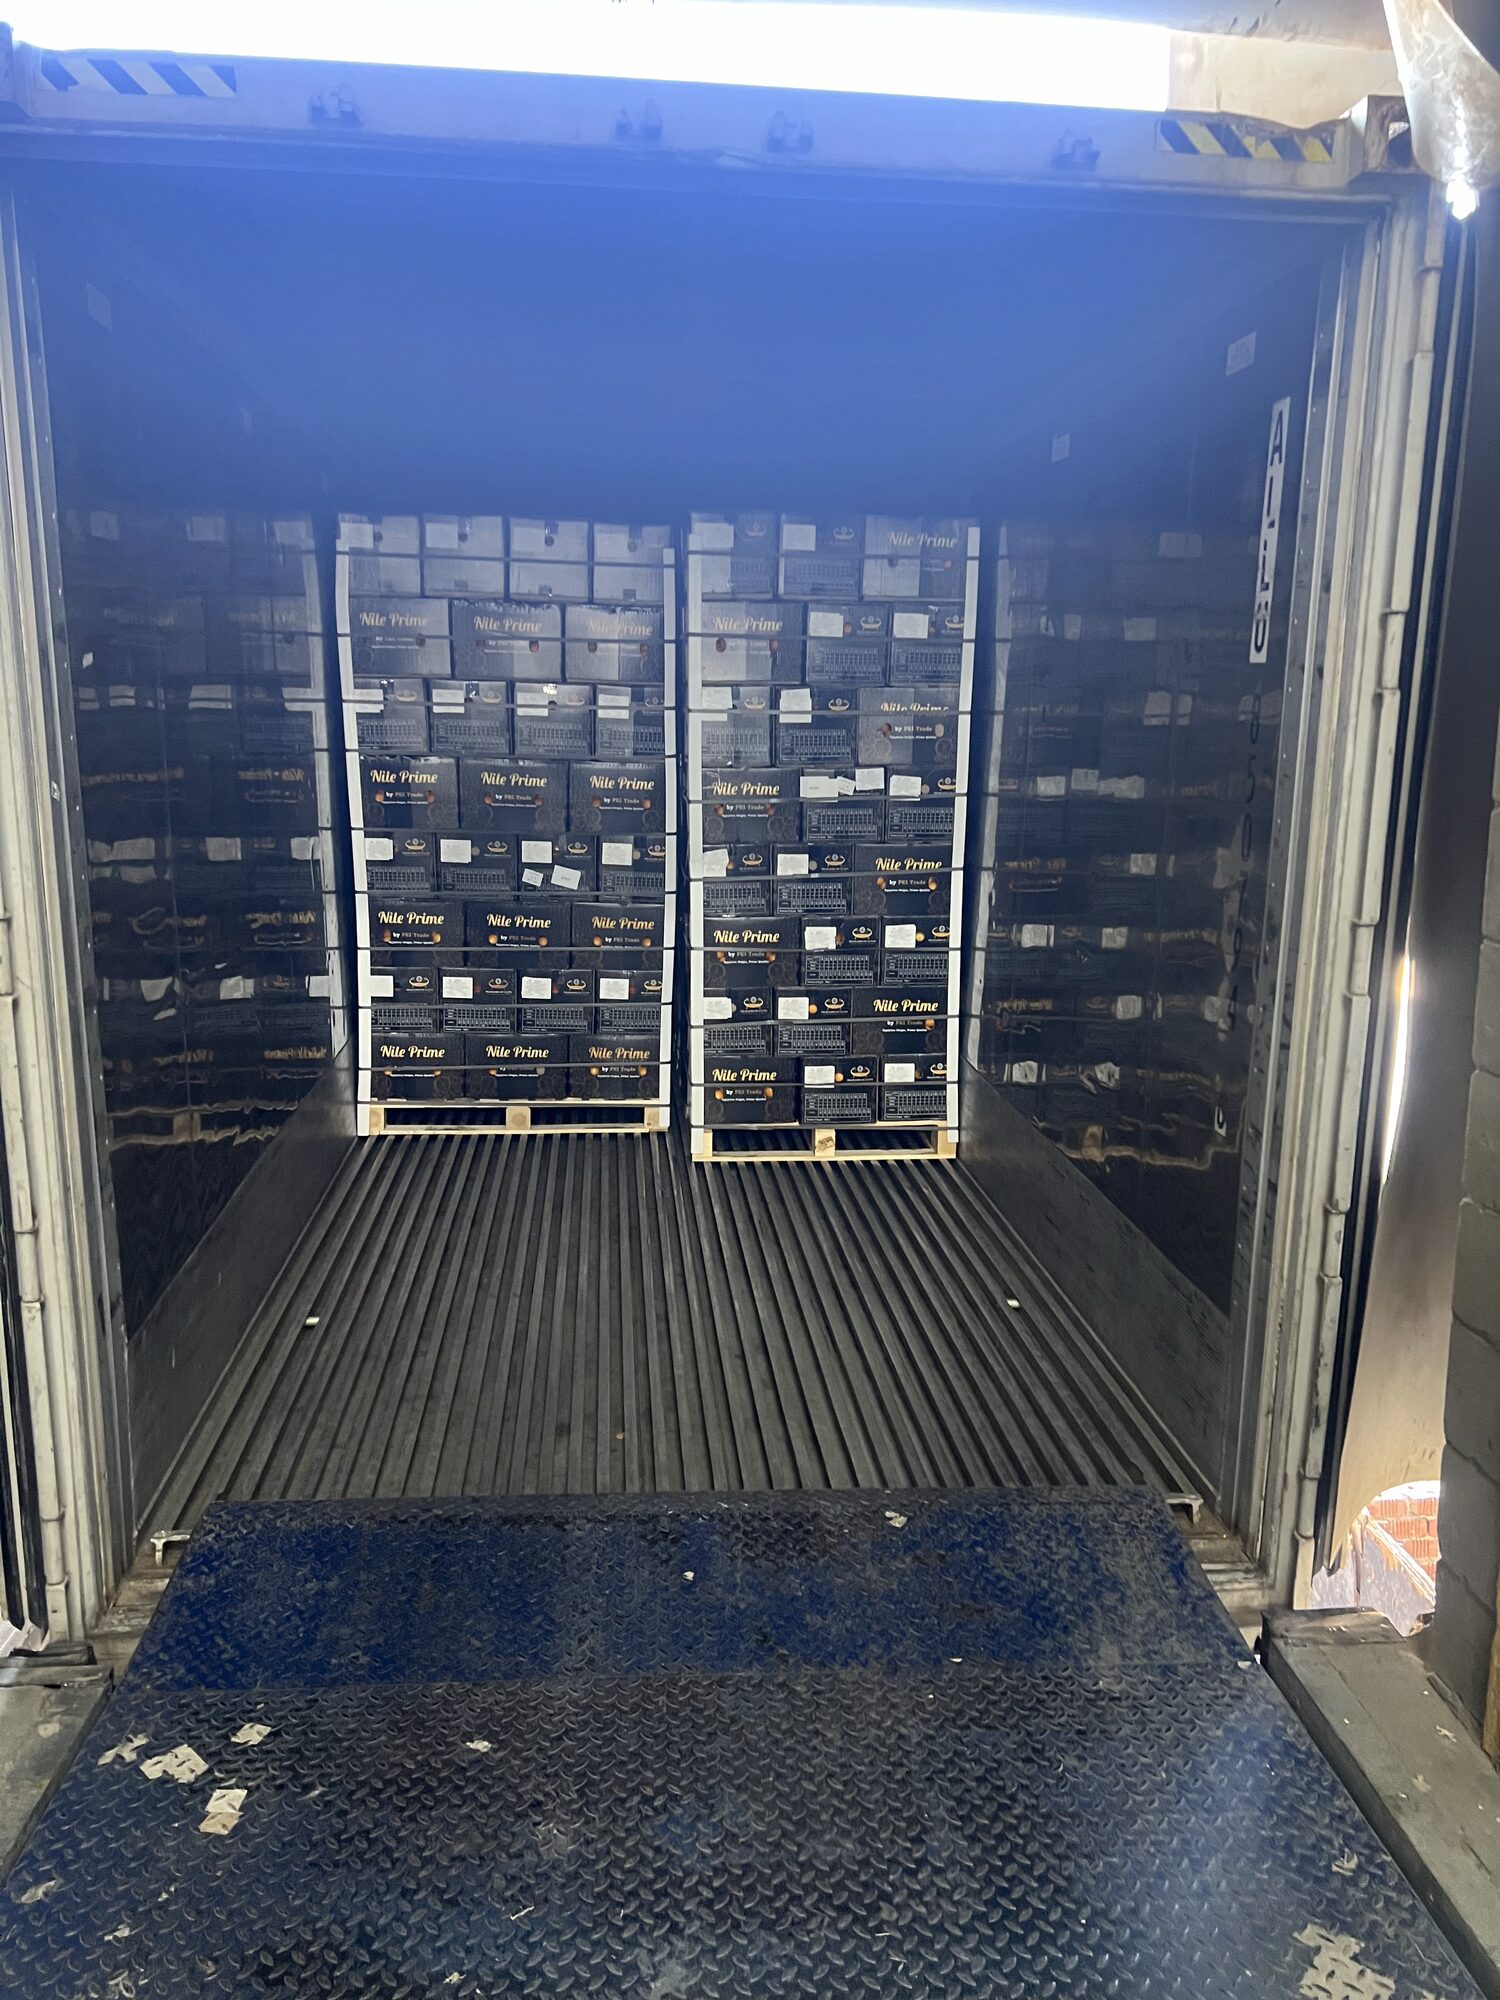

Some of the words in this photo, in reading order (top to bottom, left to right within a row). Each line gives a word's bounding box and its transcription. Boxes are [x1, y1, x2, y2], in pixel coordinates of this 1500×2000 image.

[888, 531, 914, 546] Nile
[360, 612, 386, 625] Nile
[389, 613, 427, 627] Prime
[474, 616, 500, 631] Nile
[502, 618, 541, 633] Prime
[713, 617, 740, 631] Nile
[743, 617, 783, 632] Prime
[371, 769, 397, 783] Nile
[399, 771, 438, 784] Prime
[481, 771, 507, 786] Nile
[509, 773, 547, 787] Prime
[590, 776, 615, 790] Nile
[617, 777, 655, 791] Prime
[712, 782, 739, 795] Nile
[741, 783, 779, 796] Prime
[876, 857, 901, 871] Nile
[904, 858, 943, 870] Prime
[378, 911, 404, 924] Nile
[406, 912, 444, 925] Prime
[487, 913, 512, 928] Nile
[514, 915, 551, 929] Prime
[592, 916, 617, 929] Nile
[619, 917, 655, 930] Prime
[714, 930, 739, 943] Nile
[741, 930, 780, 944] Prime
[874, 999, 898, 1012] Nile
[901, 999, 939, 1013] Prime
[381, 1045, 405, 1058] Nile
[408, 1045, 445, 1059] Prime
[486, 1045, 511, 1058] Nile
[513, 1045, 549, 1059] Prime
[589, 1047, 613, 1059] Nile
[615, 1047, 651, 1060] Prime
[712, 1069, 737, 1081] Nile
[739, 1069, 777, 1082] Prime
